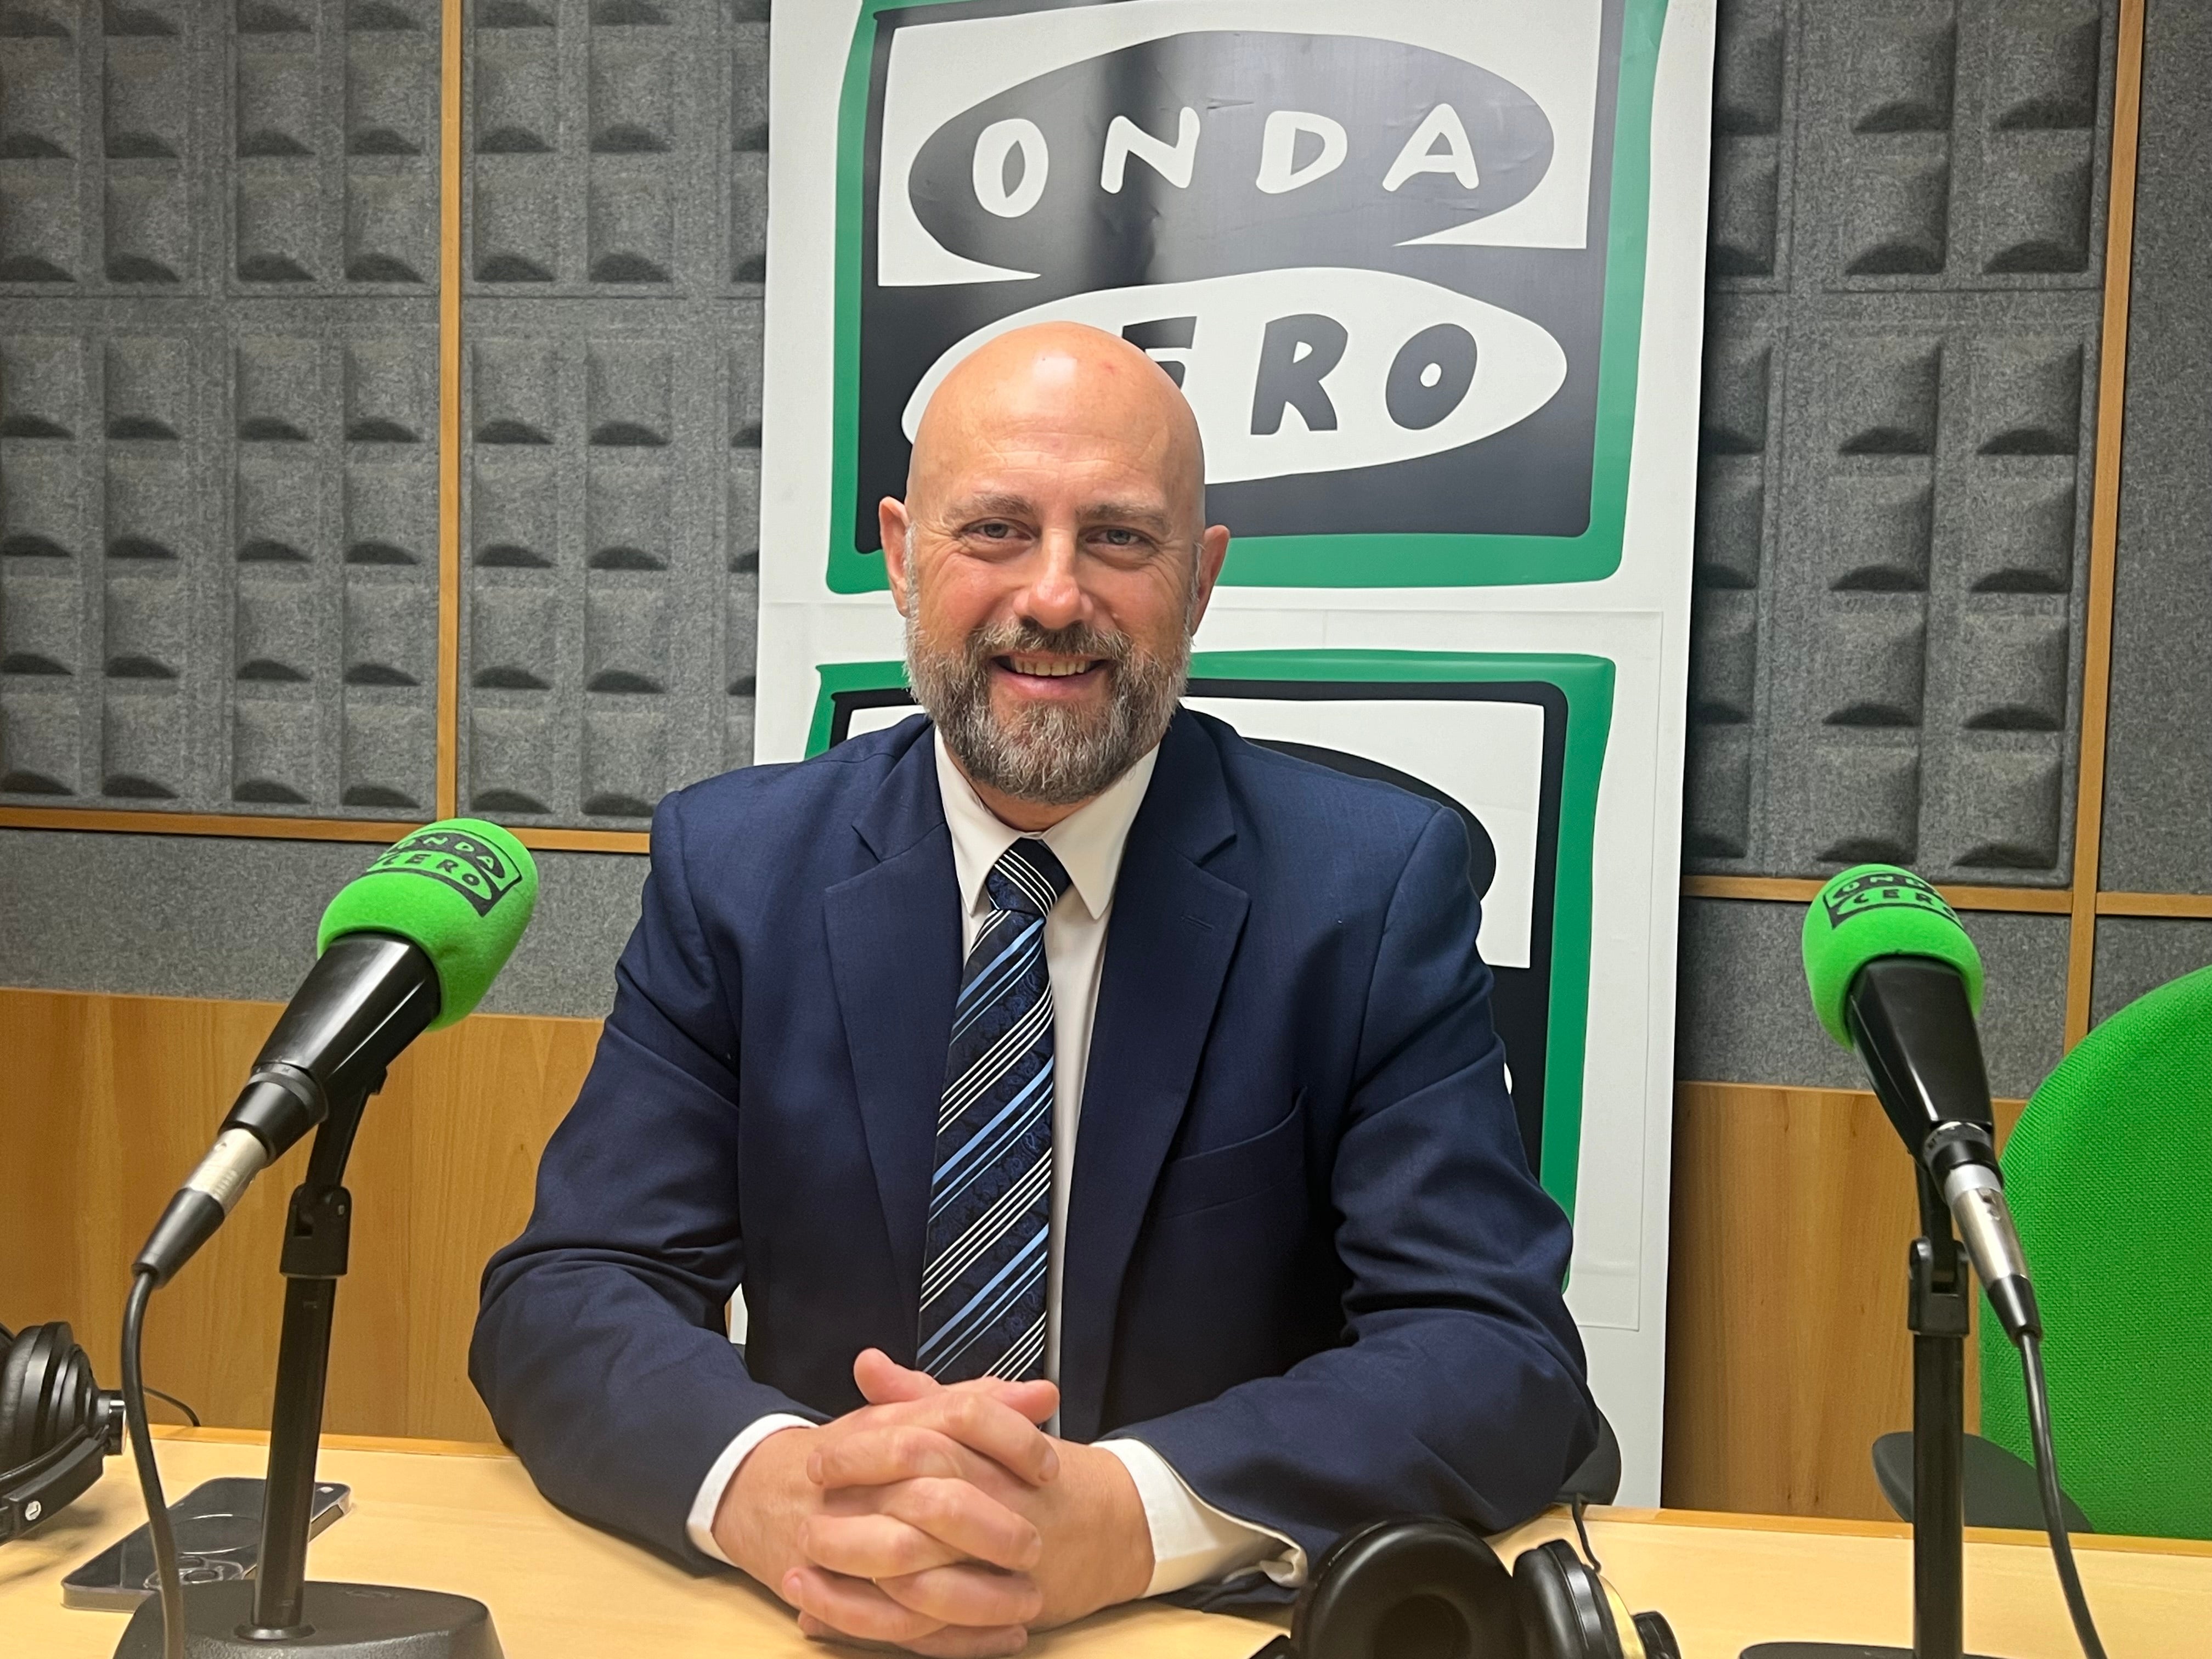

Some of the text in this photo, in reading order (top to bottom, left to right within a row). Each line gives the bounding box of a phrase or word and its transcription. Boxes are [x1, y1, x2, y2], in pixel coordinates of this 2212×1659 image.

[973, 103, 1480, 217] ONDA
[1122, 313, 1477, 435] RO
[382, 854, 481, 886] CERO
[397, 837, 494, 870] ONDA
[1842, 876, 1926, 892] OND
